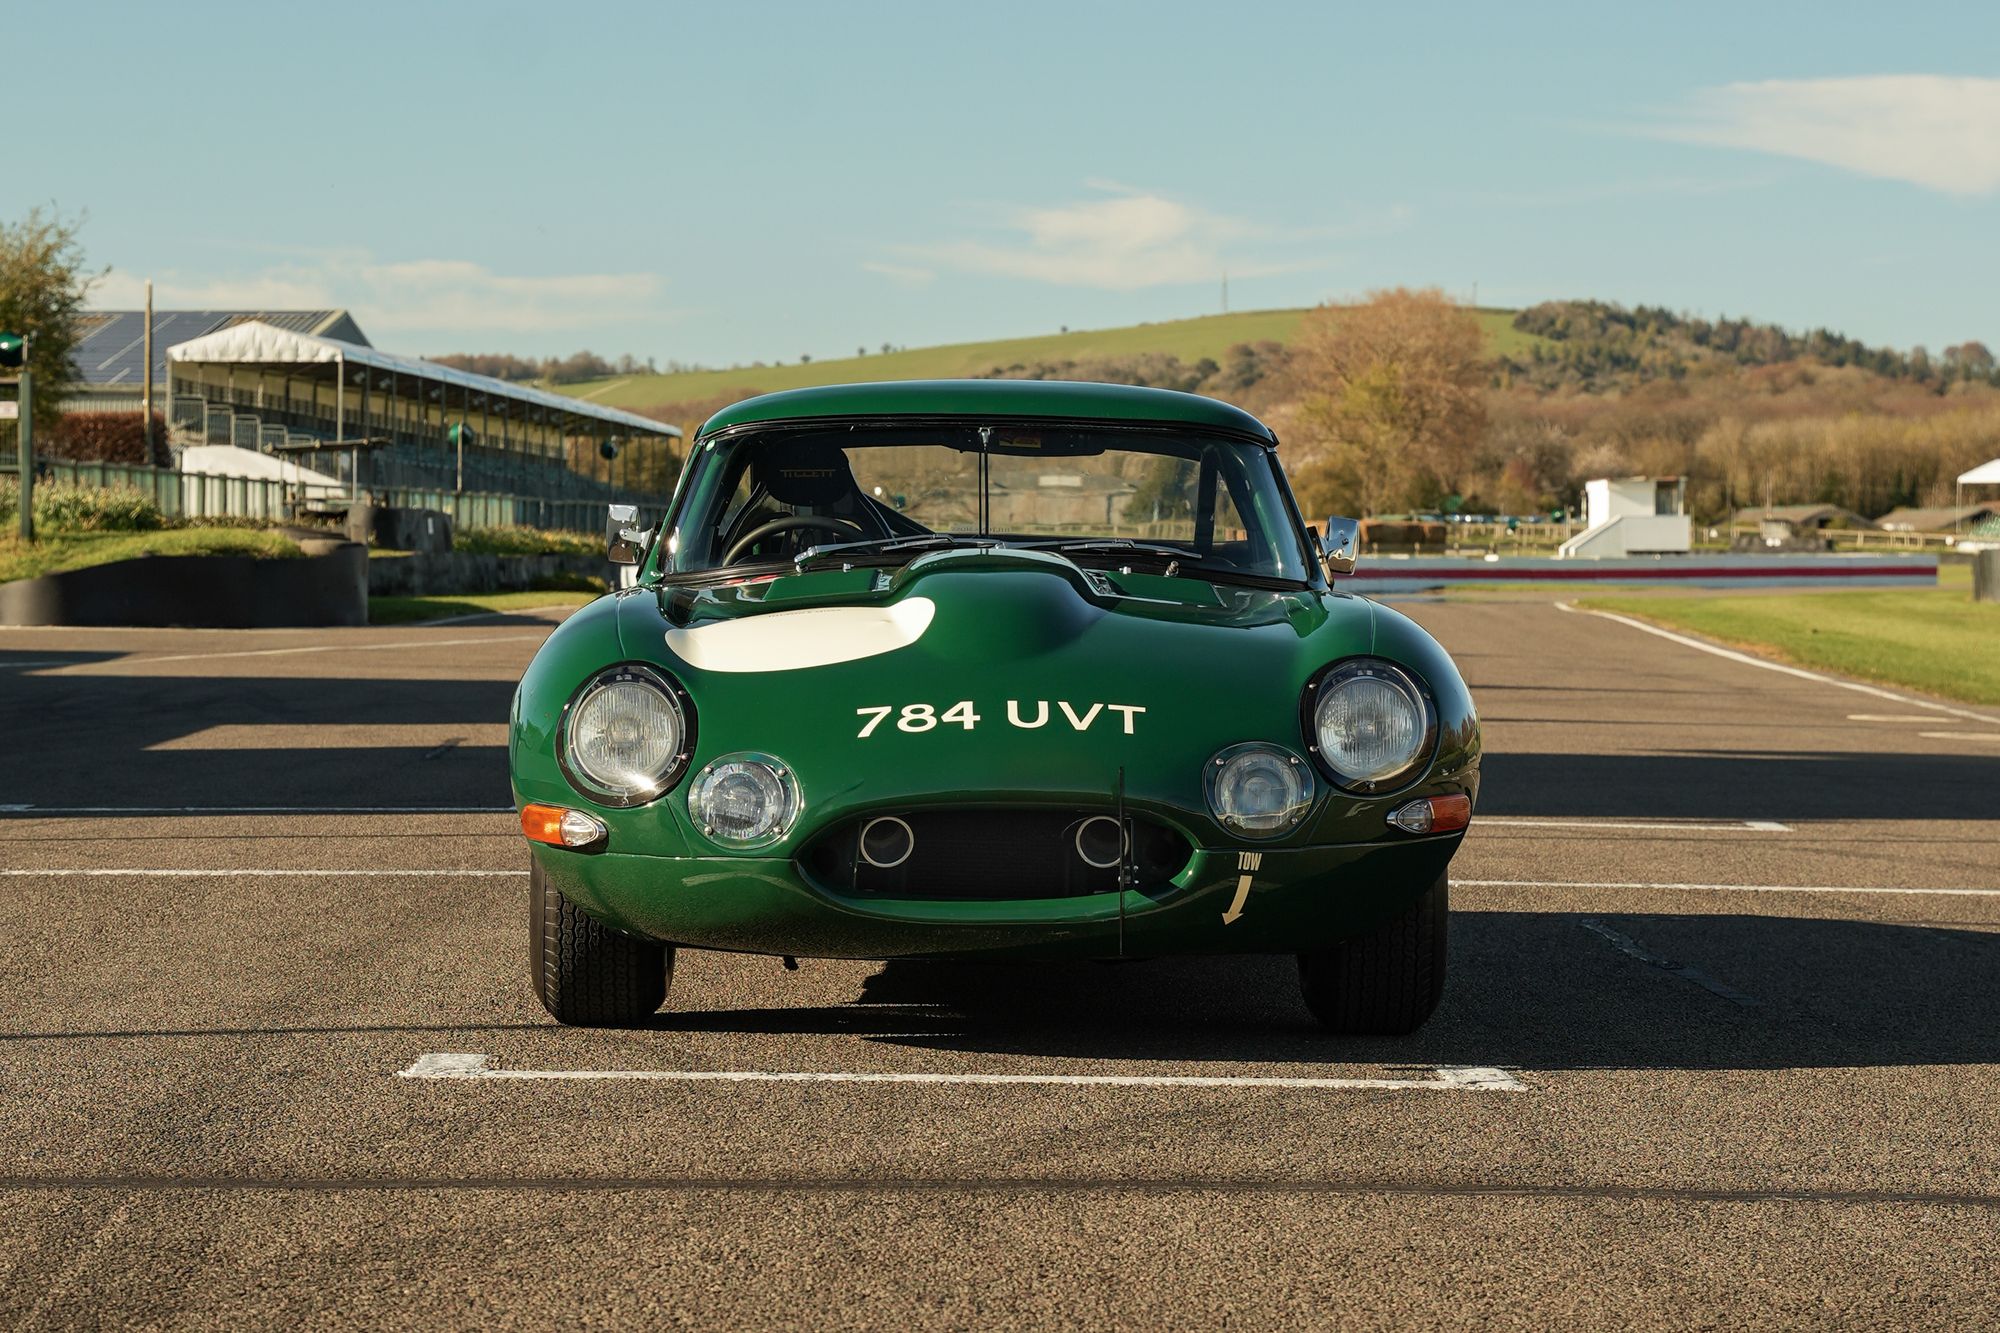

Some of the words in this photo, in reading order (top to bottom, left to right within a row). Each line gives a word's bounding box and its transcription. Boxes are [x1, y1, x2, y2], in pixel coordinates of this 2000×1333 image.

[856, 700, 981, 738] 784
[1006, 700, 1147, 735] UVT
[1237, 851, 1263, 871] TOW
